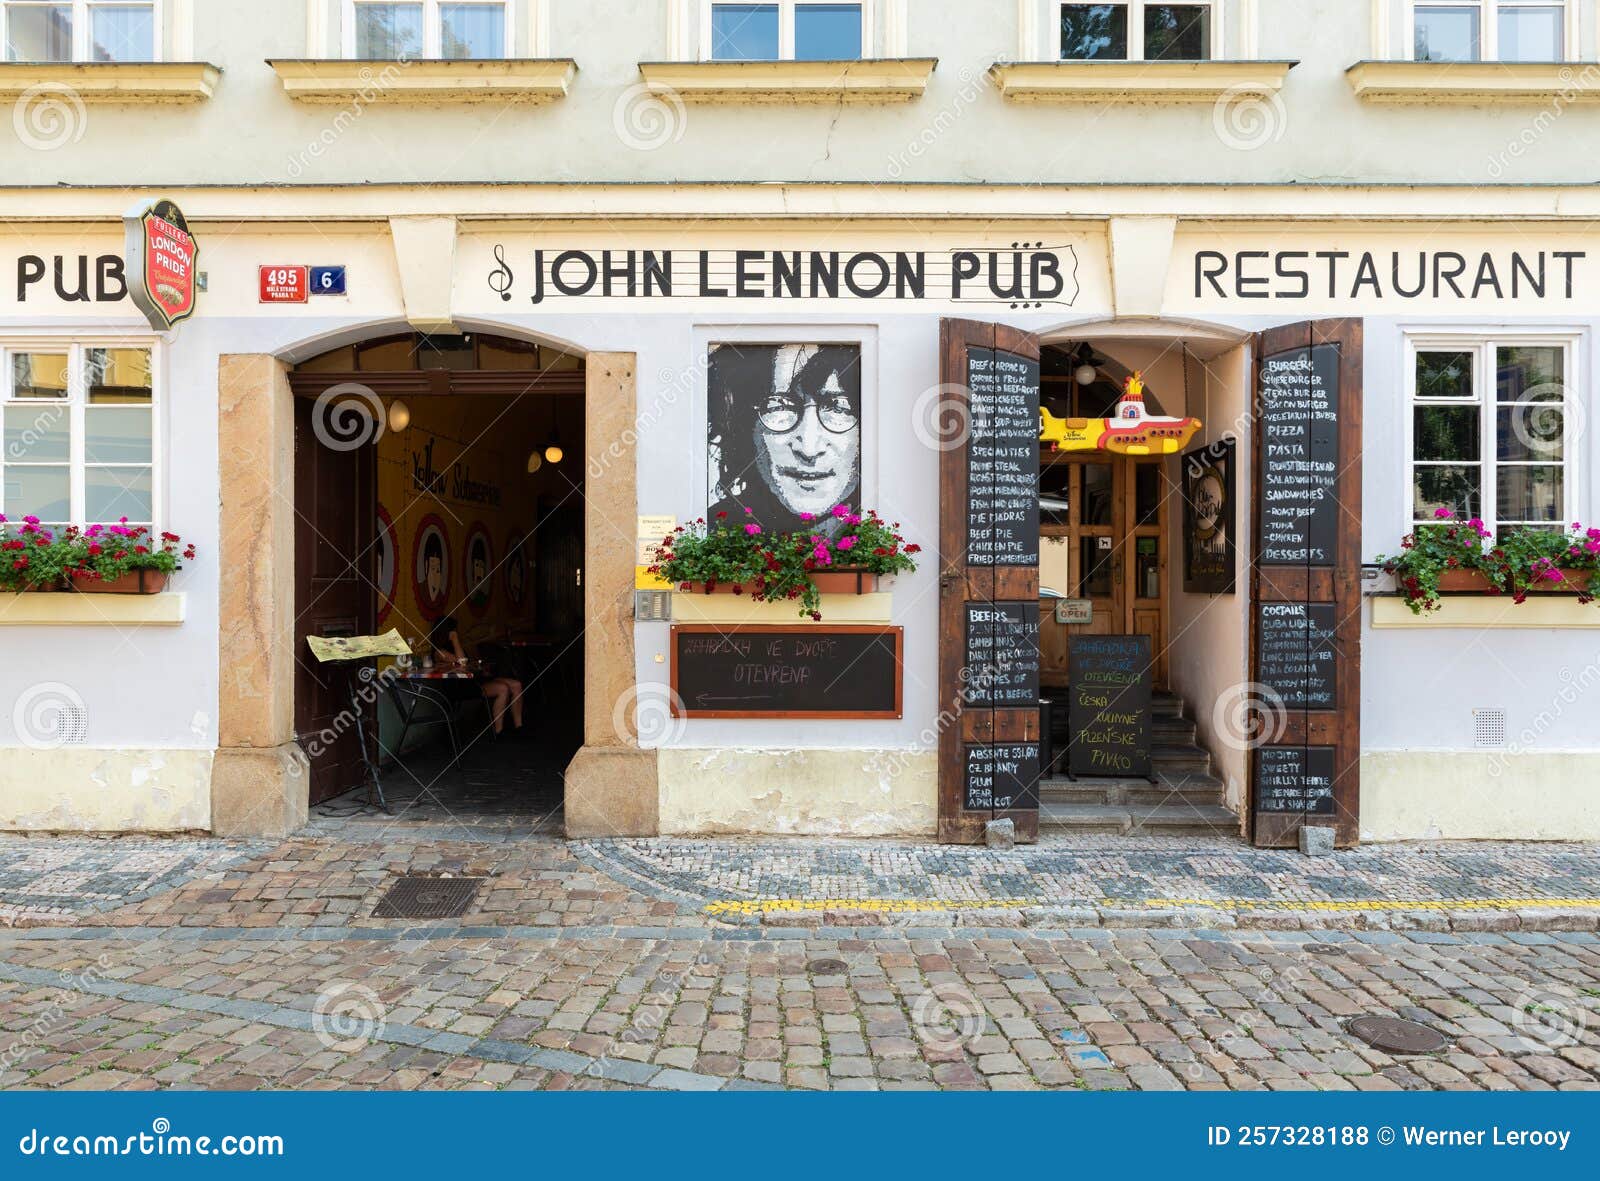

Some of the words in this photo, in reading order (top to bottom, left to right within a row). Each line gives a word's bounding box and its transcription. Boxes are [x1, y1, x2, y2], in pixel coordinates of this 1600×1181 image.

[151, 236, 190, 267] LONDON
[156, 252, 185, 277] PRIDE
[17, 255, 128, 302] PUB
[268, 269, 297, 285] 495
[321, 272, 333, 288] 6
[531, 250, 672, 304] JOHN
[700, 250, 925, 298] LENNON
[952, 252, 1064, 299] PUB
[1195, 252, 1586, 298] RESTAURANT
[1267, 425, 1304, 436] PIZZA
[1268, 444, 1304, 456] PASTA
[970, 529, 992, 539] BEEF
[996, 529, 1014, 538] PIE
[1007, 542, 1024, 552] PIE
[968, 554, 993, 565] FRIED
[969, 610, 1008, 622] BEERS
